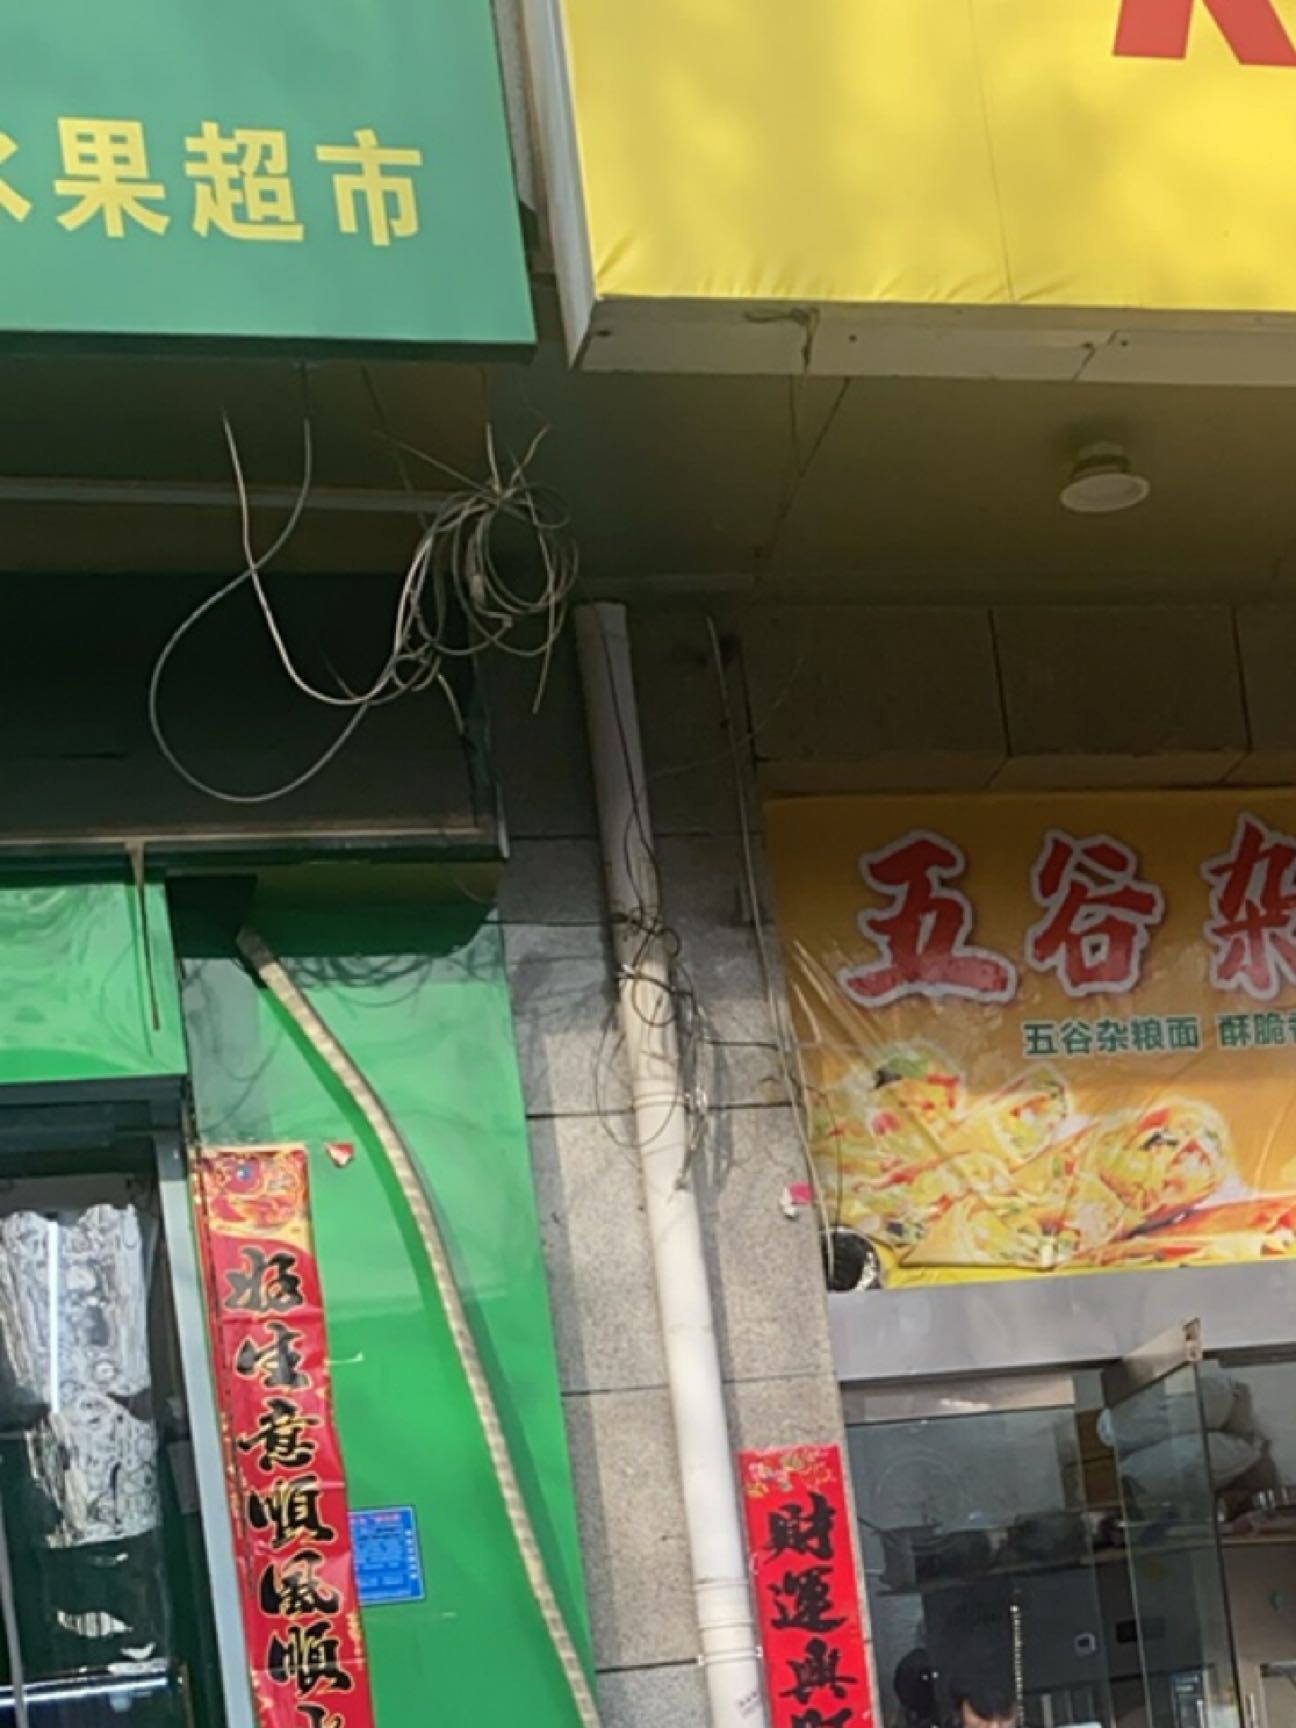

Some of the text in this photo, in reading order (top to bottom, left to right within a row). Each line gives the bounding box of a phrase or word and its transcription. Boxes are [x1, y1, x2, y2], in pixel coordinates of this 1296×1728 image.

[1022, 1013, 1202, 1057] 五谷杂粮面
